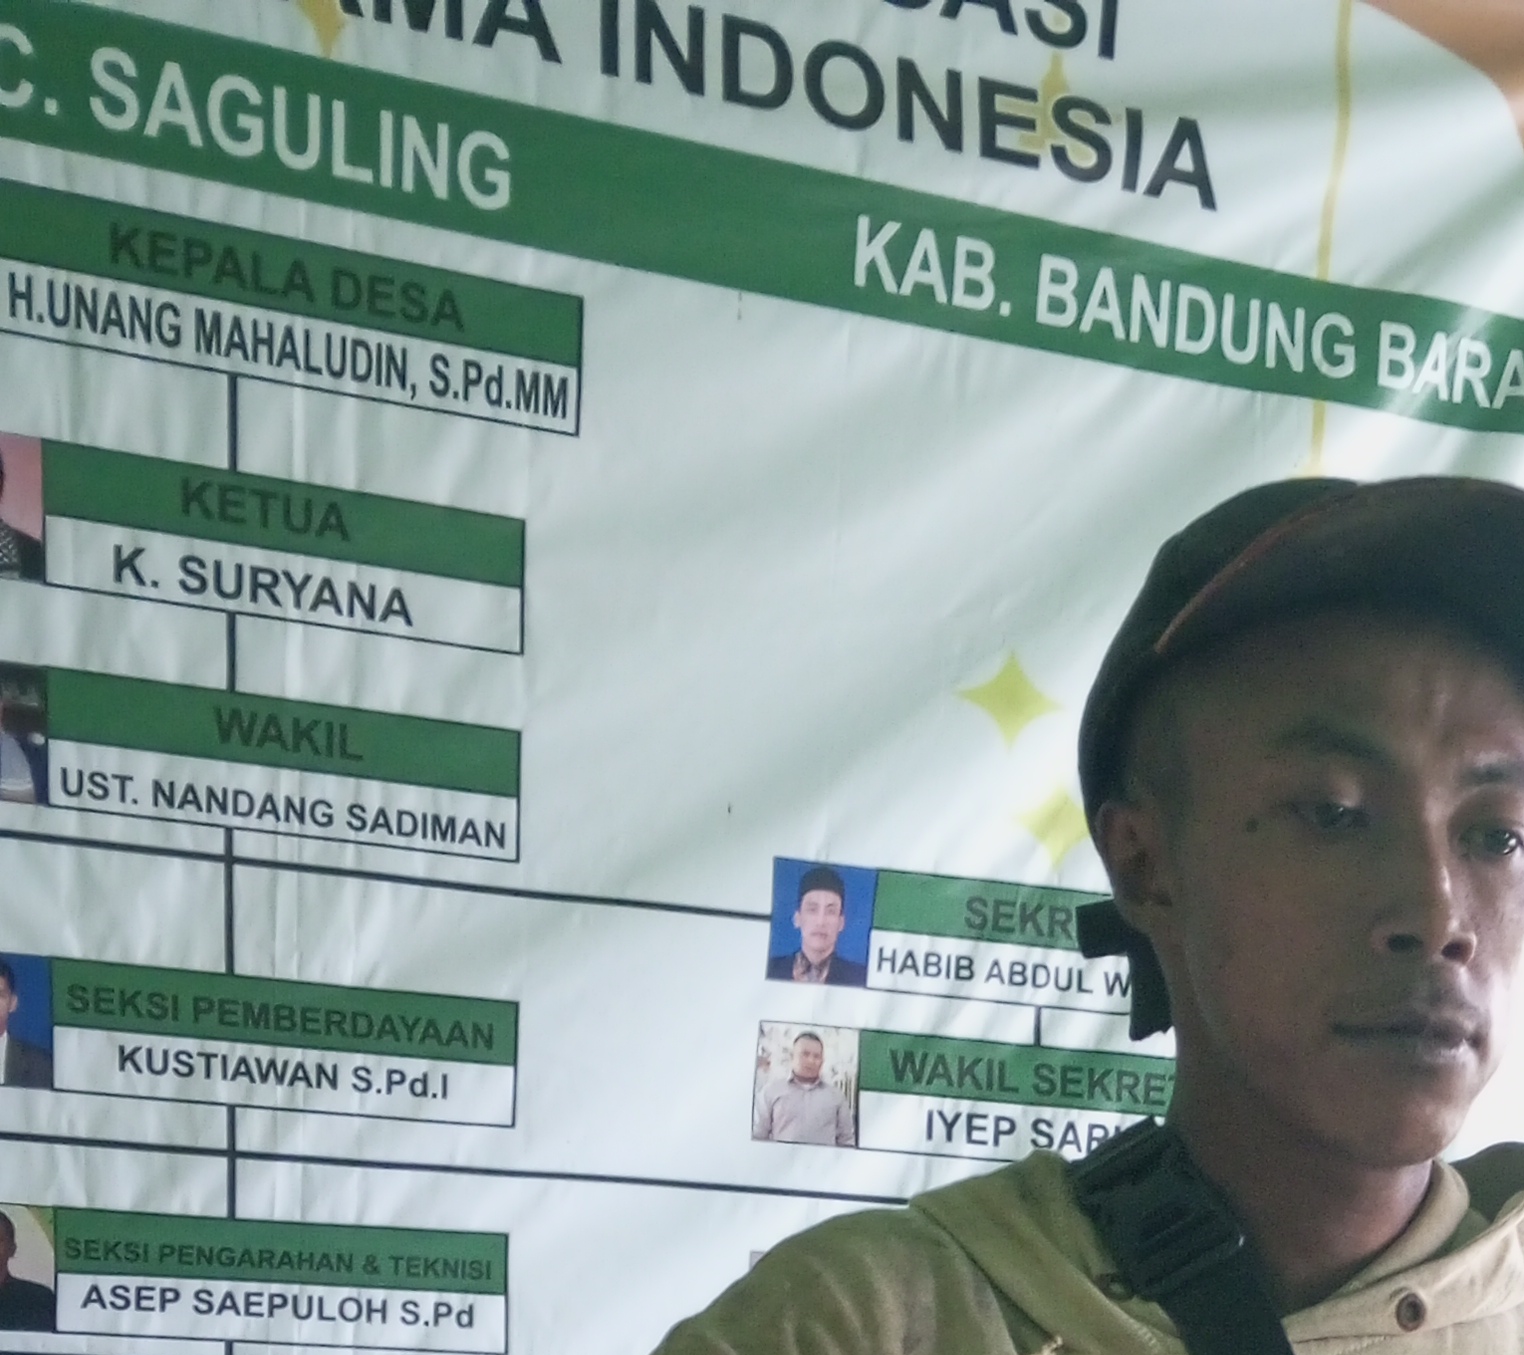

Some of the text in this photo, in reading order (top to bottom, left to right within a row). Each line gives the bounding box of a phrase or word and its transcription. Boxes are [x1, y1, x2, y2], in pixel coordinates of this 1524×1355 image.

[89, 46, 513, 211] SAGULING
[600, 0, 1219, 212] INDONESIA
[109, 221, 466, 333] KEPALA DESA
[854, 213, 1013, 319] KAB.
[1035, 254, 1357, 381] BANDUNG
[8, 272, 570, 421] H.UNANG MAHALUDIN, S.Pd.MM
[180, 476, 351, 543] KETUA
[112, 543, 414, 628] K. SURYANA
[213, 705, 365, 763] WAKIL
[60, 766, 507, 851] UST. NANDANG SADIMAN
[964, 895, 1074, 941] SEKR
[876, 946, 1132, 998] HABIB ABDUL W
[65, 982, 496, 1051] SEKSI PEMBERDAYAAN
[118, 1044, 450, 1100] KUSTIAWAN S.Pd.I
[888, 1048, 1176, 1107] WAKIL SEKRE
[925, 1109, 1017, 1147] IYEP
[64, 1236, 494, 1281] SEKSI PENGARAHAN & TEKNISI
[81, 1283, 476, 1330] ASEP SAEPULOH S.Pd
